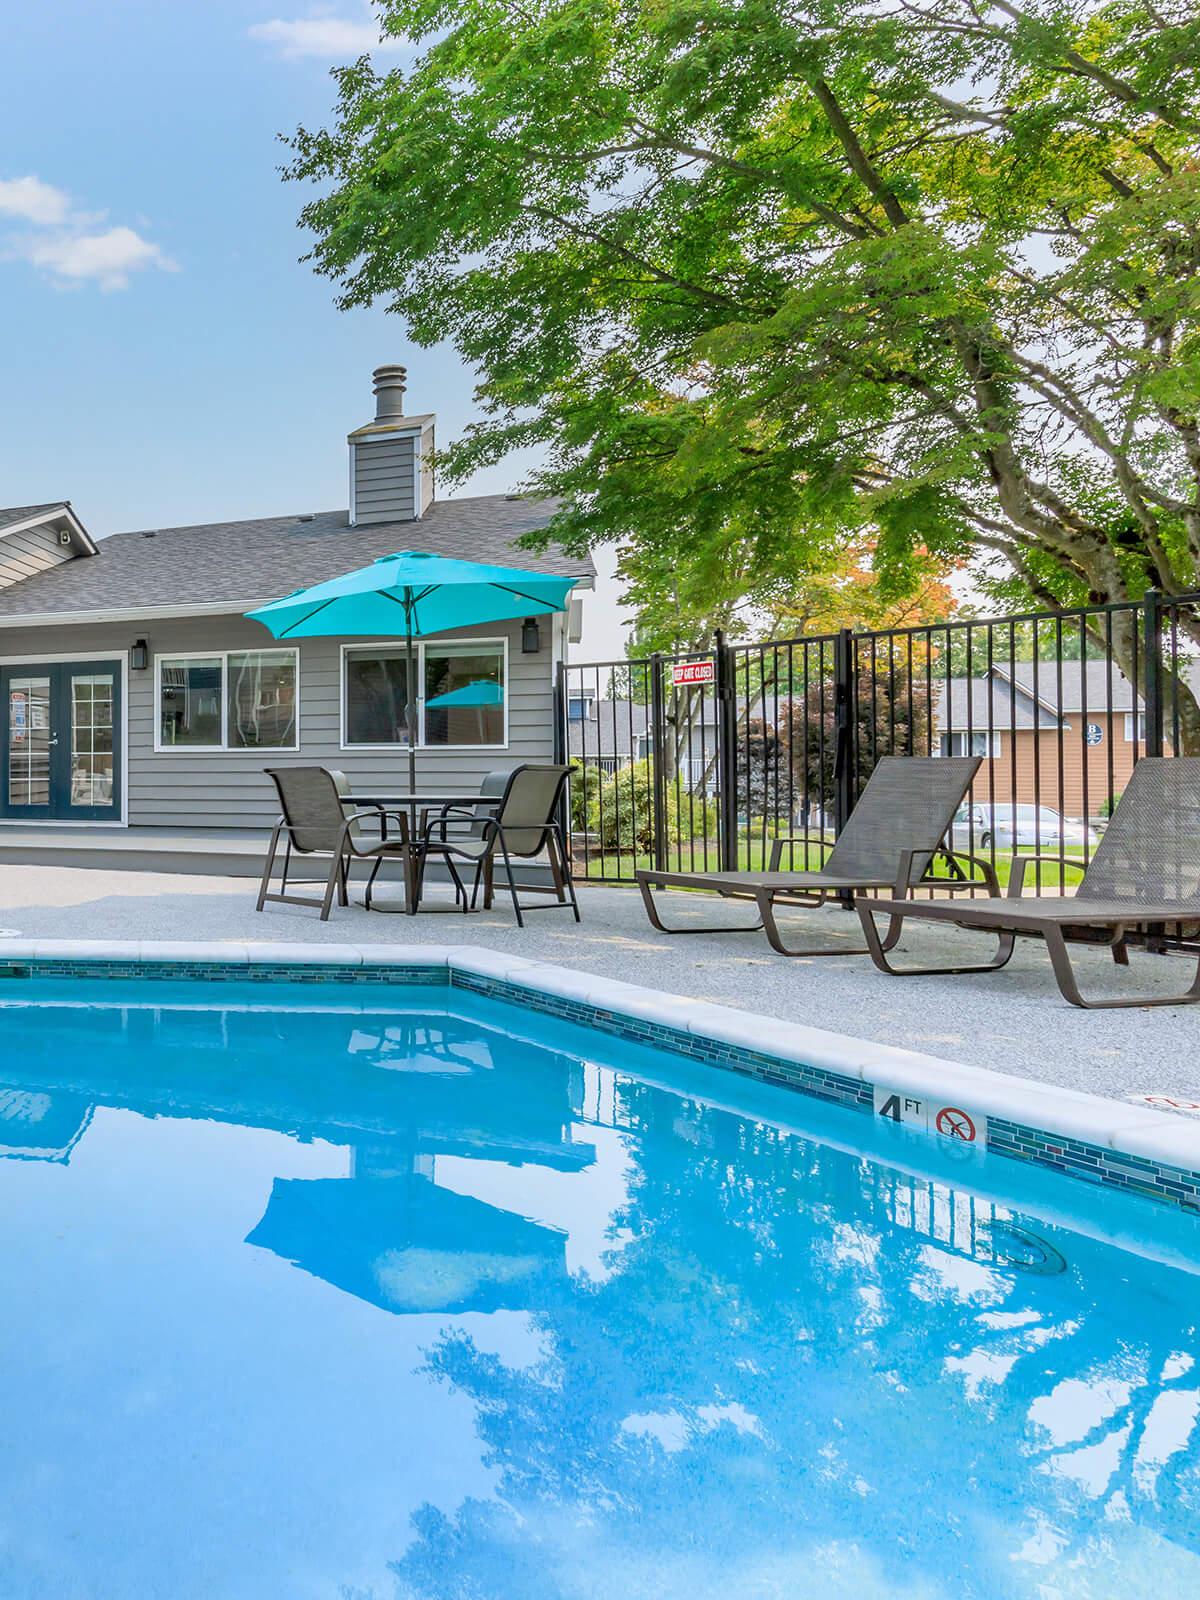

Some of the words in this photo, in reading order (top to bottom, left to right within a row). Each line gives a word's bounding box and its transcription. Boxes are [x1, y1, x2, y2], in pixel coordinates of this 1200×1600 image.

[684, 667, 694, 679] GATE
[695, 665, 712, 679] CLOSED
[879, 1095, 904, 1122] 4
[904, 1098, 922, 1115] FT
